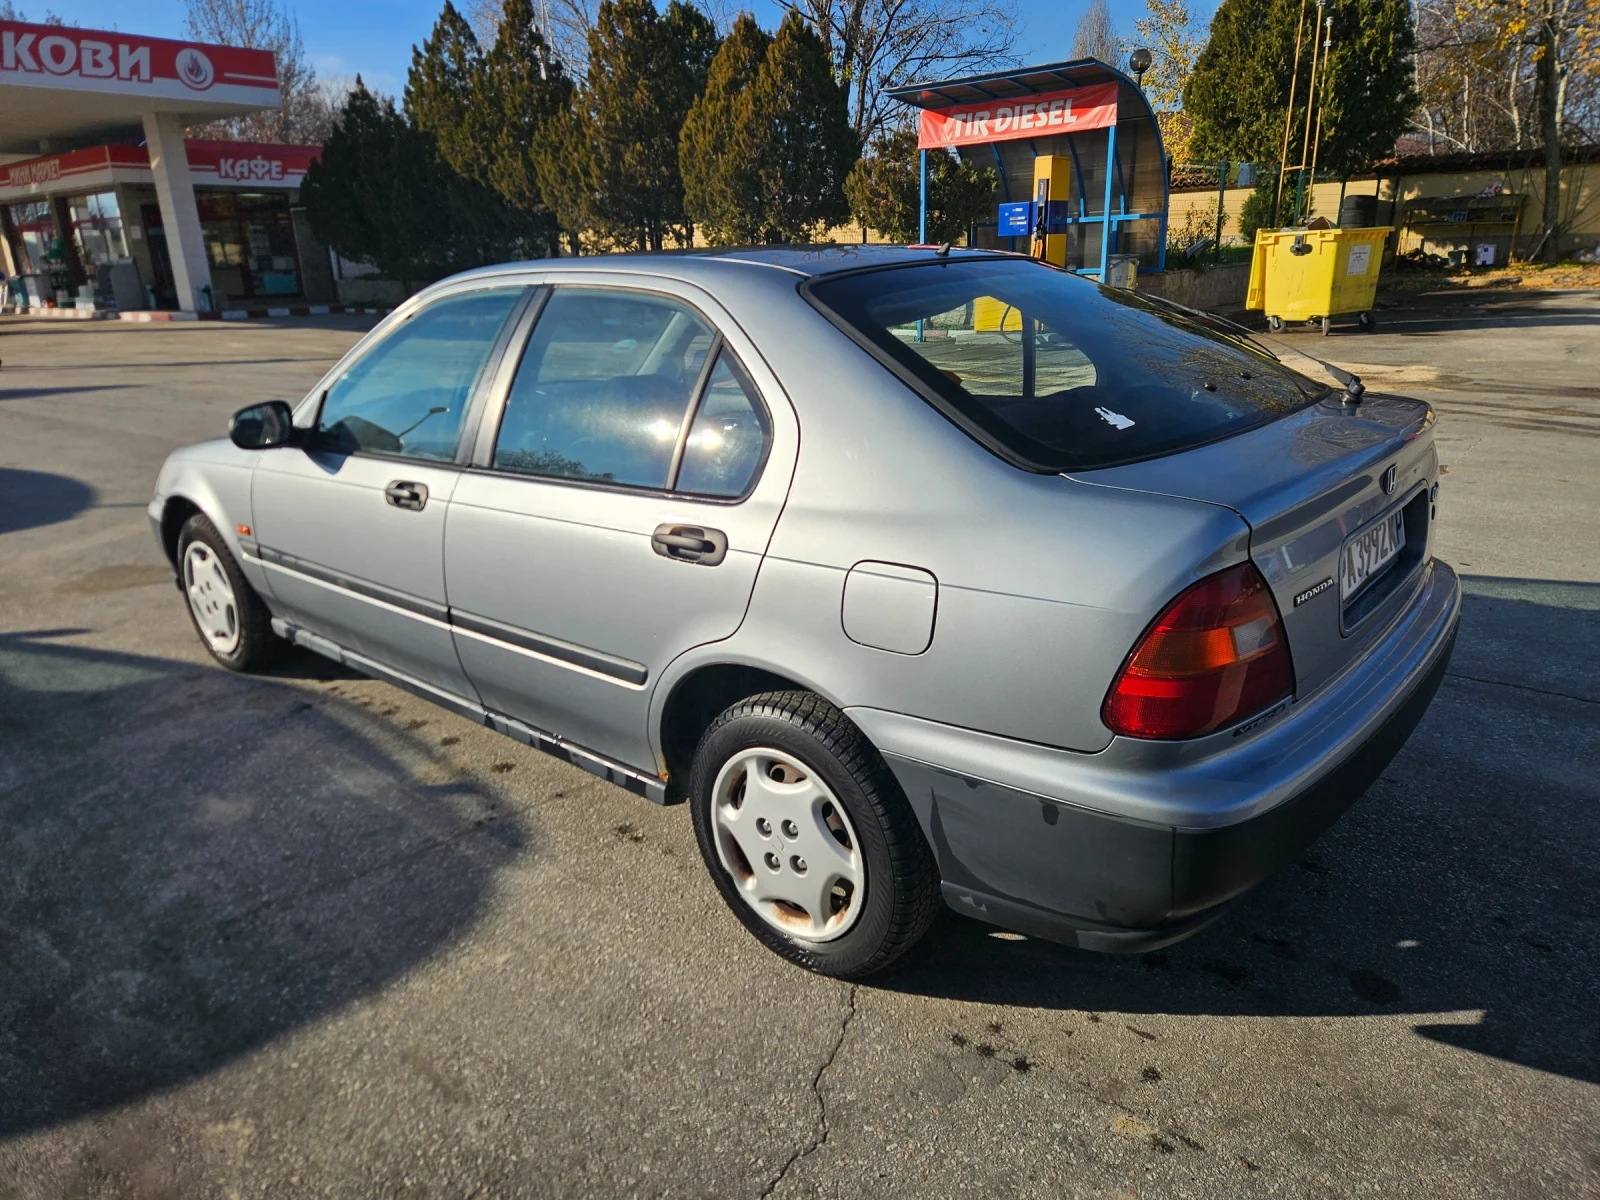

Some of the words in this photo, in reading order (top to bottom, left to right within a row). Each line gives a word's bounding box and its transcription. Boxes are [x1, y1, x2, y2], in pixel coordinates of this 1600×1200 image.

[2, 31, 151, 81] КОВИ
[953, 111, 991, 138] TIR
[994, 98, 1077, 133] DIESEL
[219, 155, 284, 180] КАФЕ
[1295, 578, 1333, 605] HONDA
